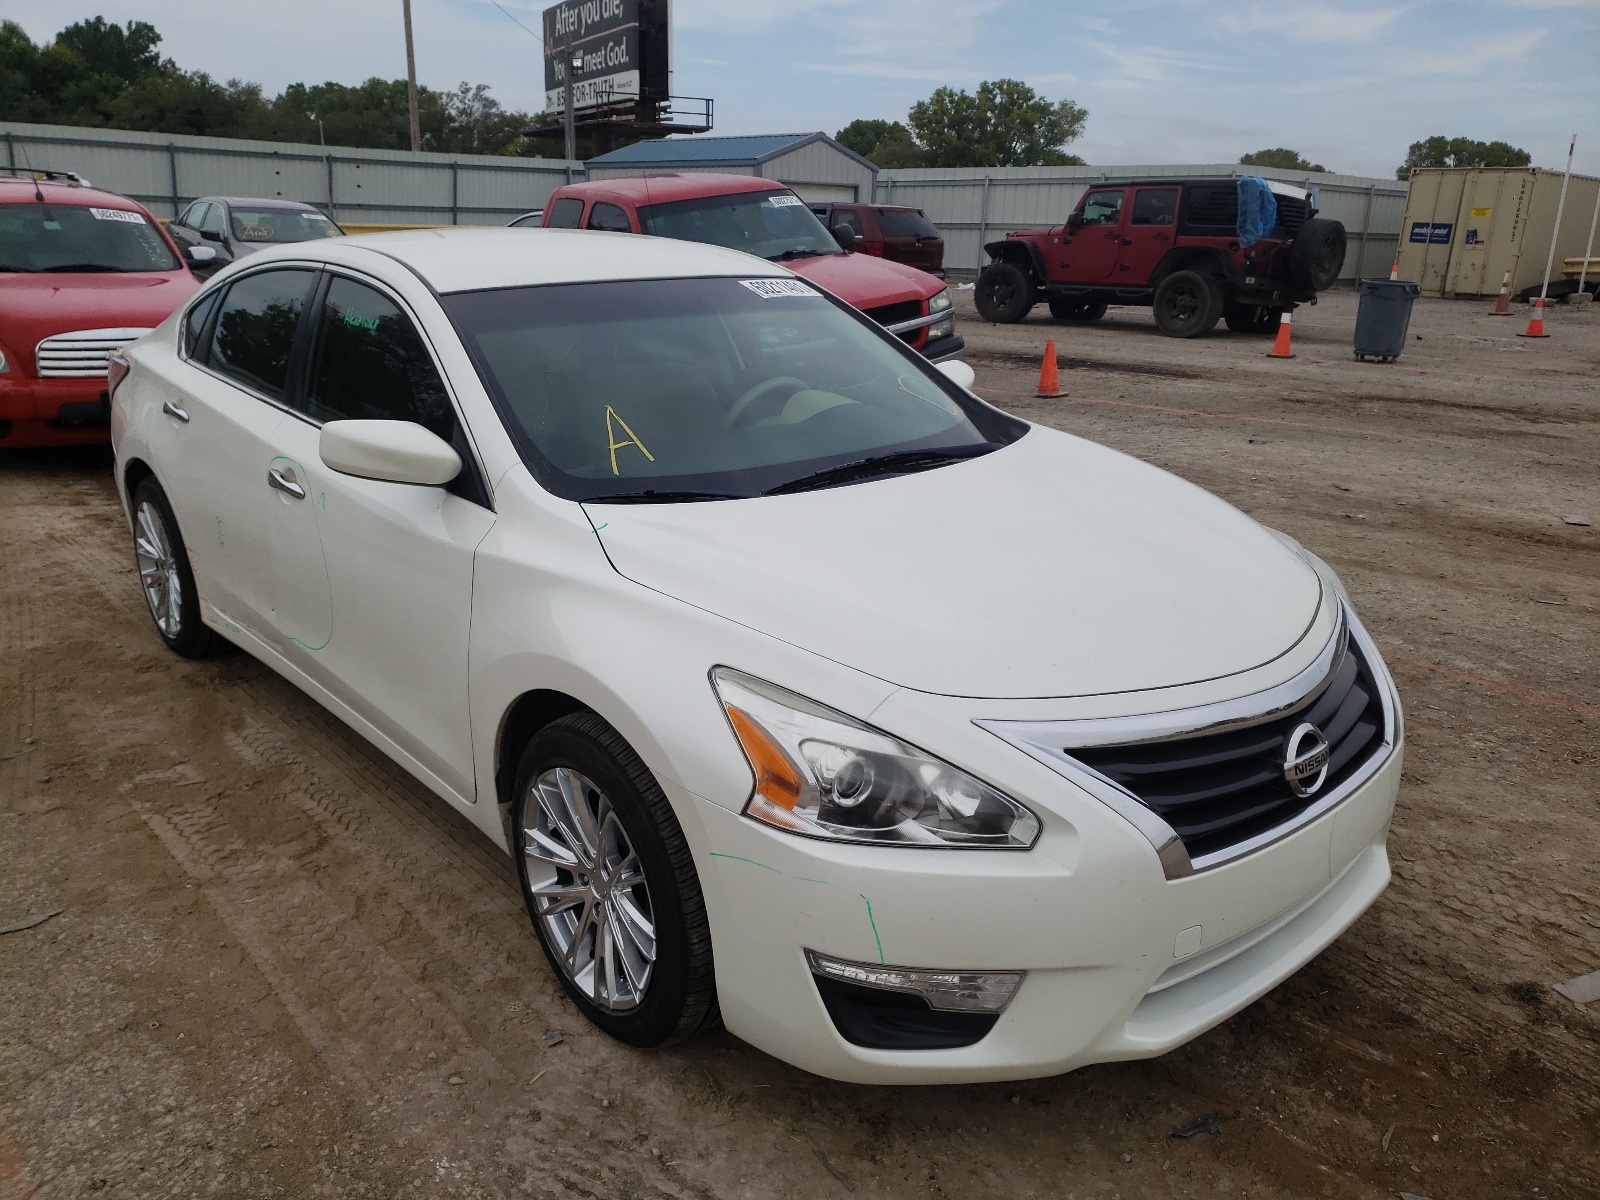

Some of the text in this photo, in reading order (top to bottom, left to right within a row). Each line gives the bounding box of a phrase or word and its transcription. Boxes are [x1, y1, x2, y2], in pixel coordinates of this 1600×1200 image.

[555, 4, 578, 37] After
[580, 0, 600, 35] you
[584, 46, 605, 73] meet
[607, 36, 629, 66] God.
[605, 405, 655, 476] A
[1294, 750, 1329, 776] NISSAN
